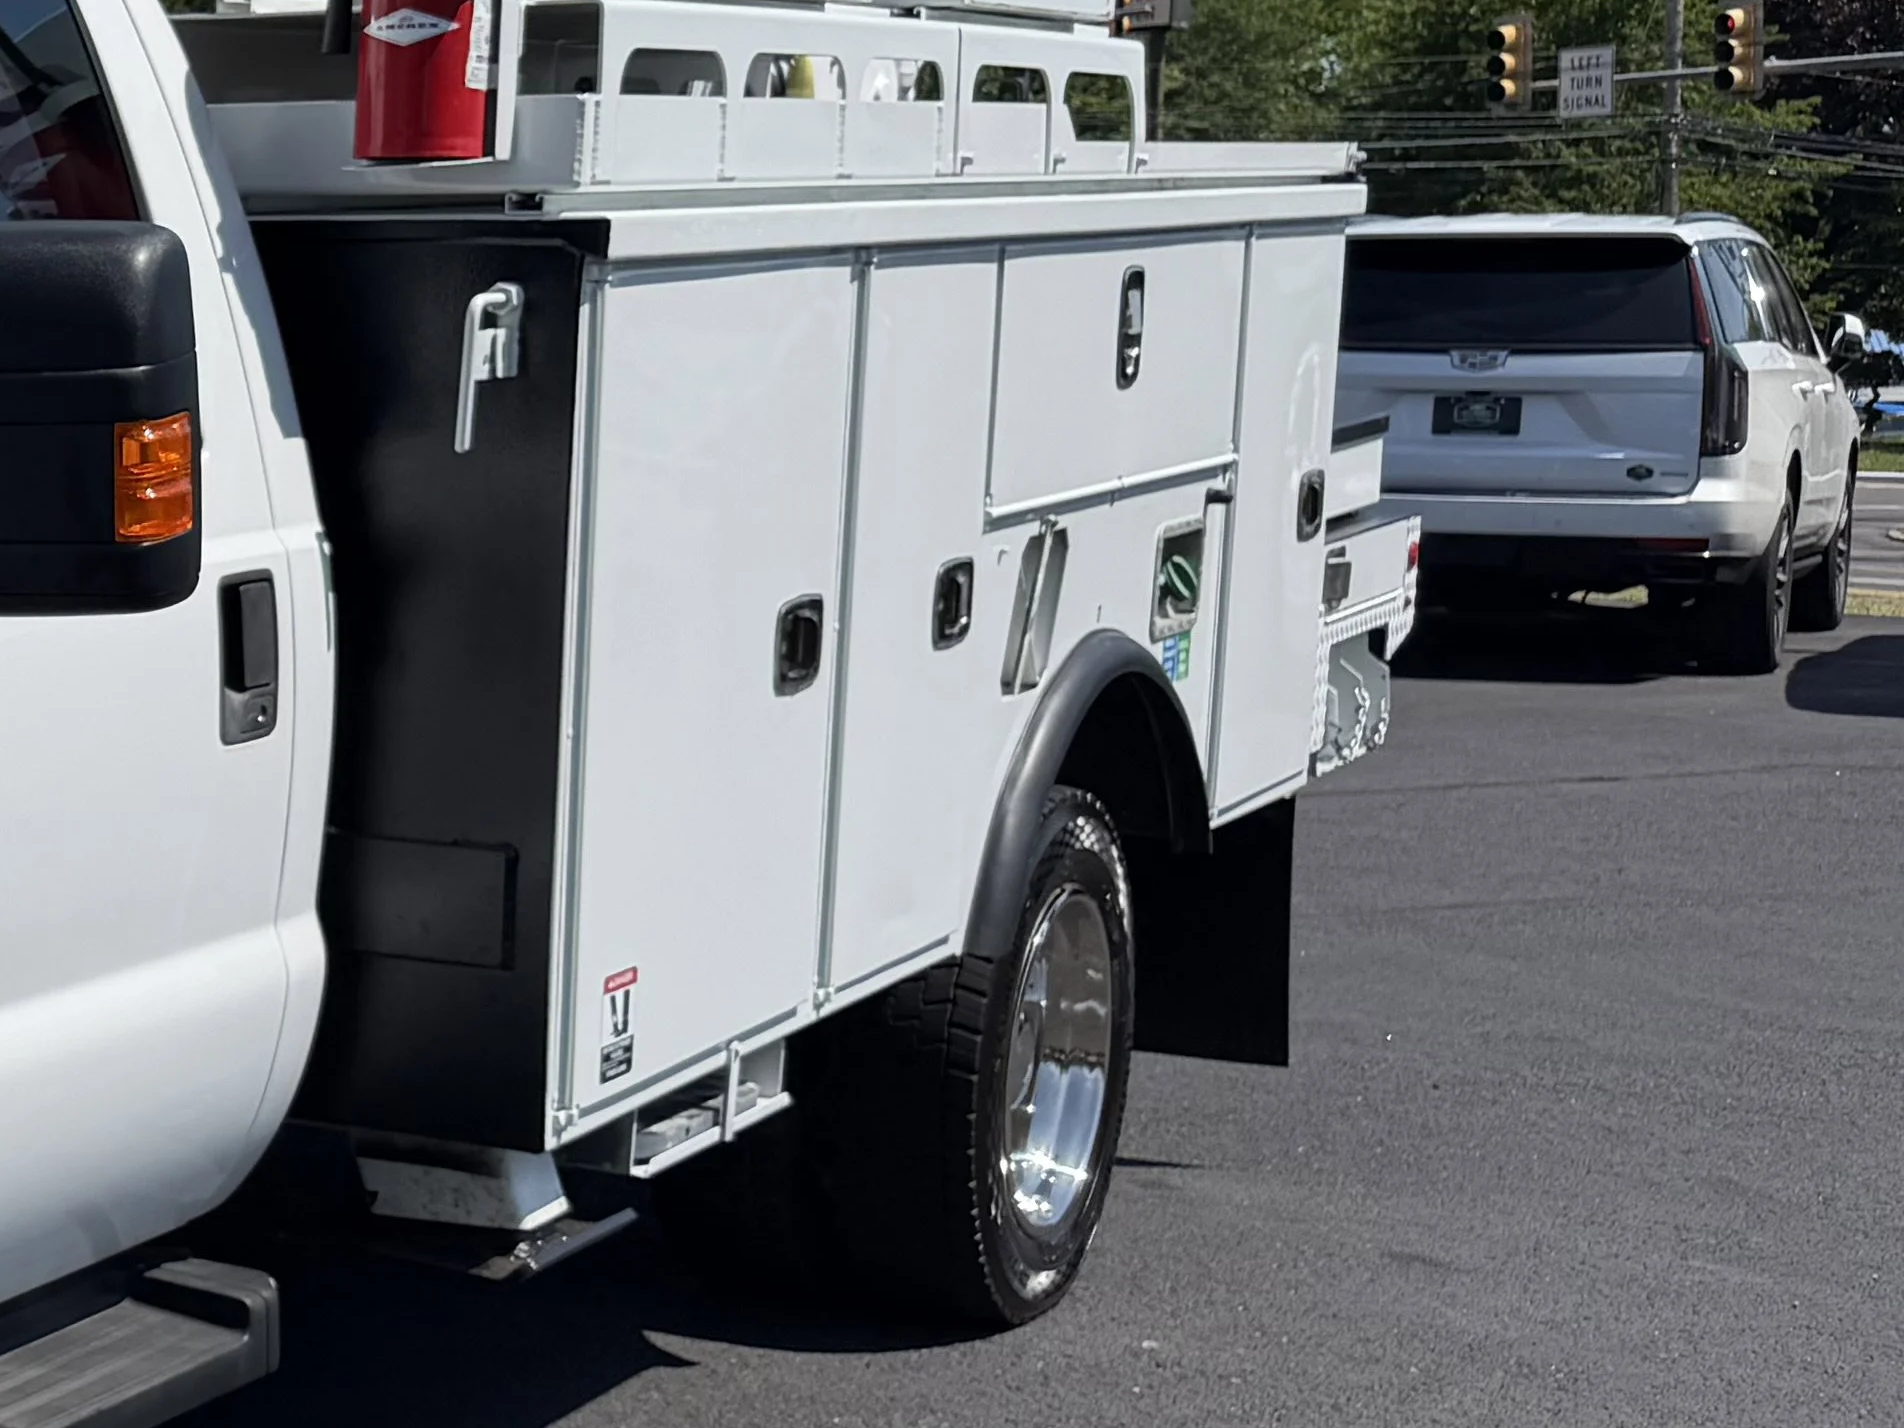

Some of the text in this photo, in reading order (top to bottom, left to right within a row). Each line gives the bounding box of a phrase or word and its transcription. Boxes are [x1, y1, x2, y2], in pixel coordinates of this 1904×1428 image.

[1571, 54, 1602, 71] LEFT
[1571, 74, 1603, 90] TURN
[1563, 94, 1606, 110] SIGNAL
